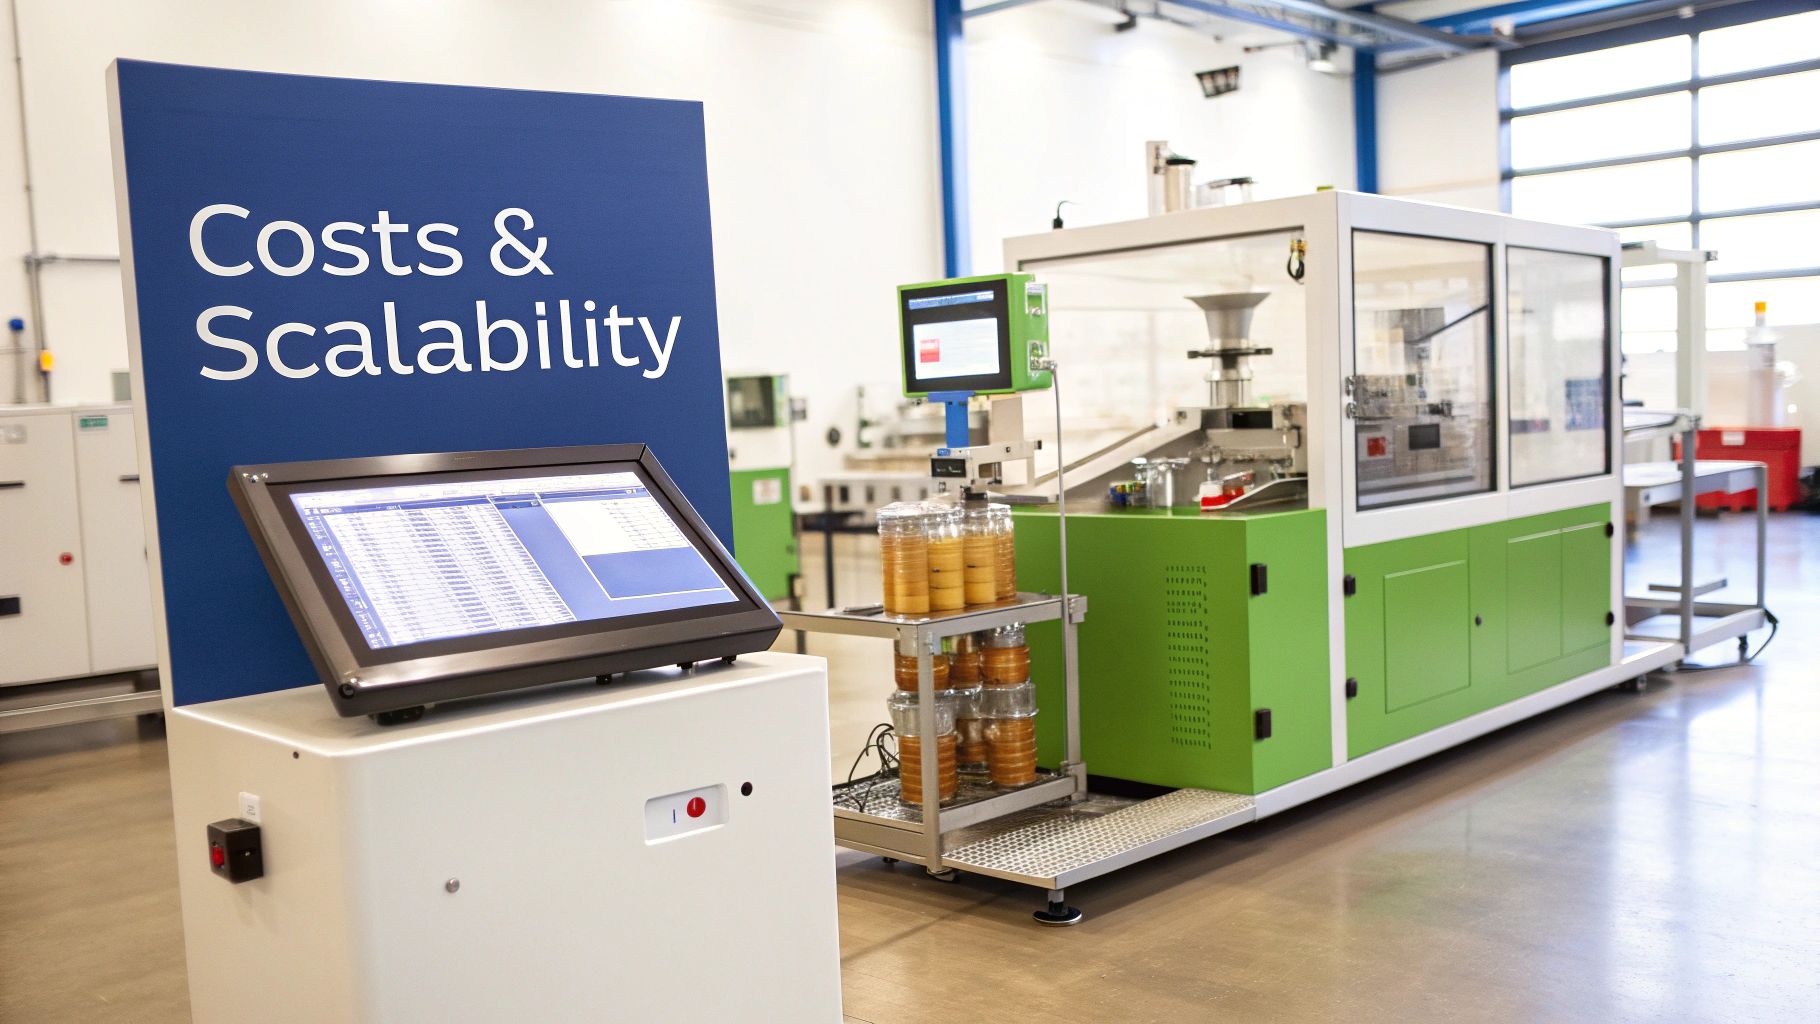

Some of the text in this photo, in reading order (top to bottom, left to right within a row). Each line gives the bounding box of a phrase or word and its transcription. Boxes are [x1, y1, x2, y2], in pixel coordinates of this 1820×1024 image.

[189, 203, 554, 277] Costs &
[196, 299, 682, 381] Scalability
